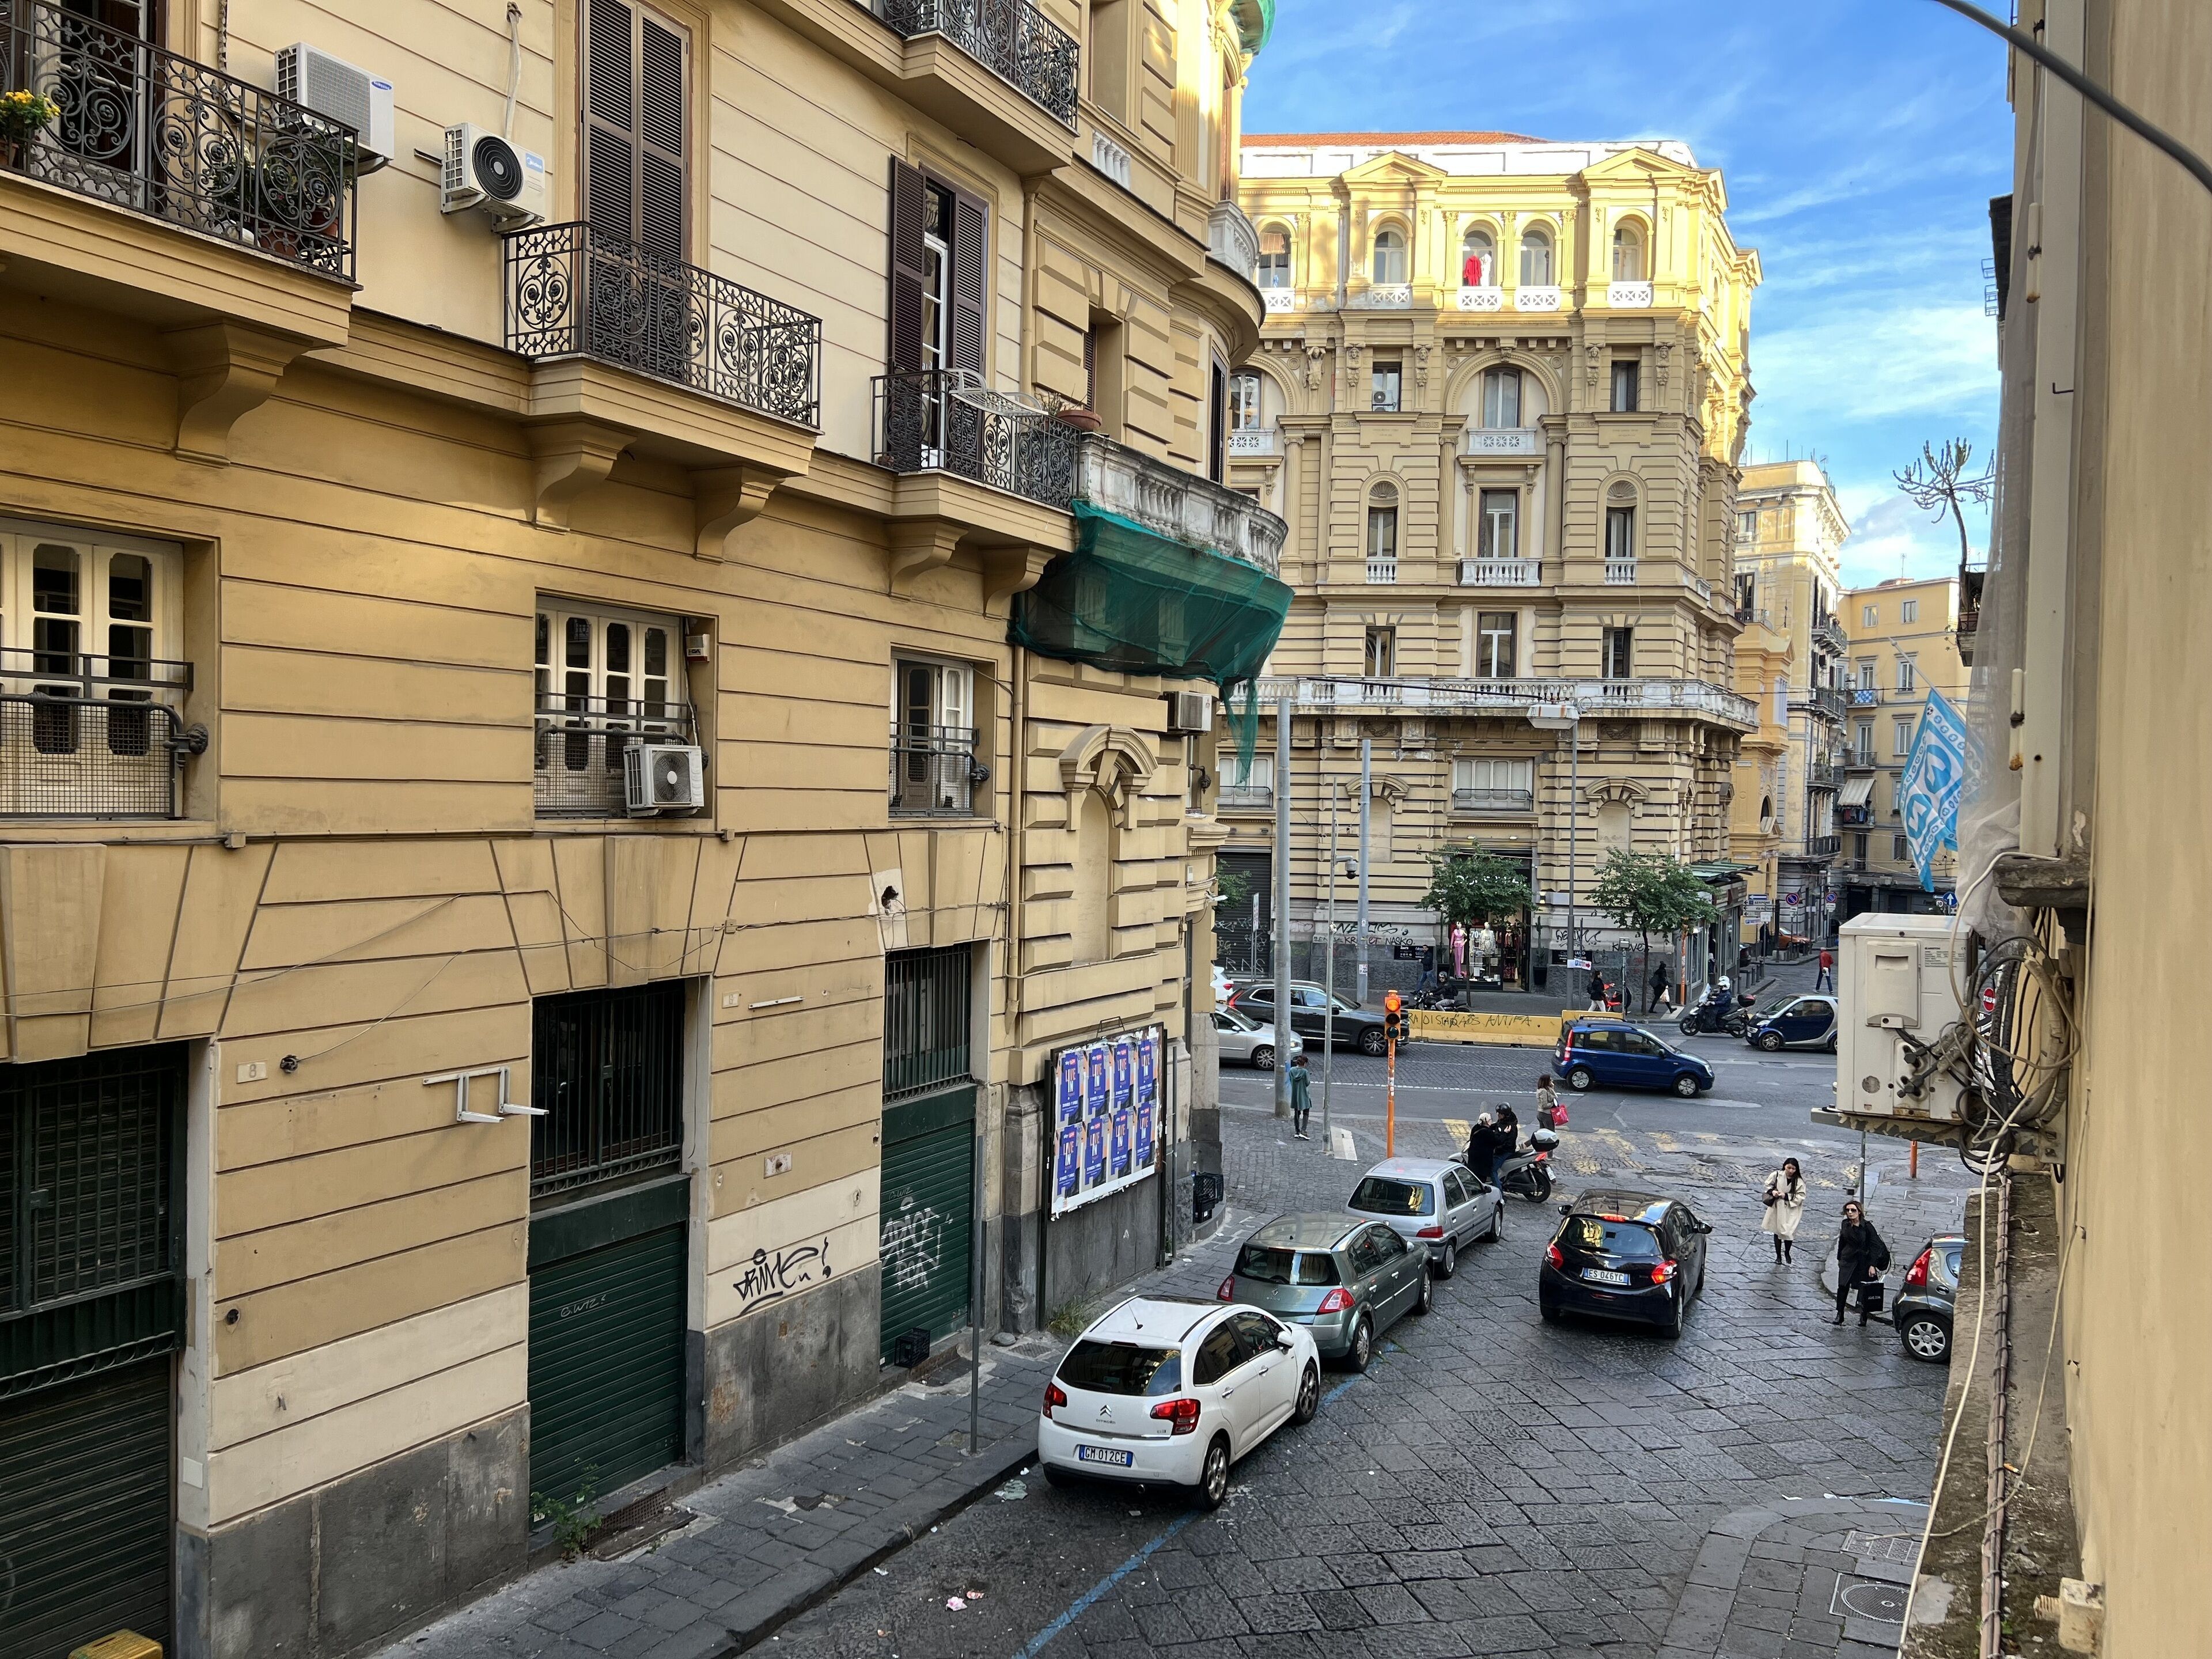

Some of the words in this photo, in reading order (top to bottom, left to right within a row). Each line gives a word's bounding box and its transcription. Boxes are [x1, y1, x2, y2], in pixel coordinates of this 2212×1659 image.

[249, 1064, 257, 1078] 8
[1085, 1447, 1096, 1459] GM
[1098, 1449, 1126, 1463] 012CE
